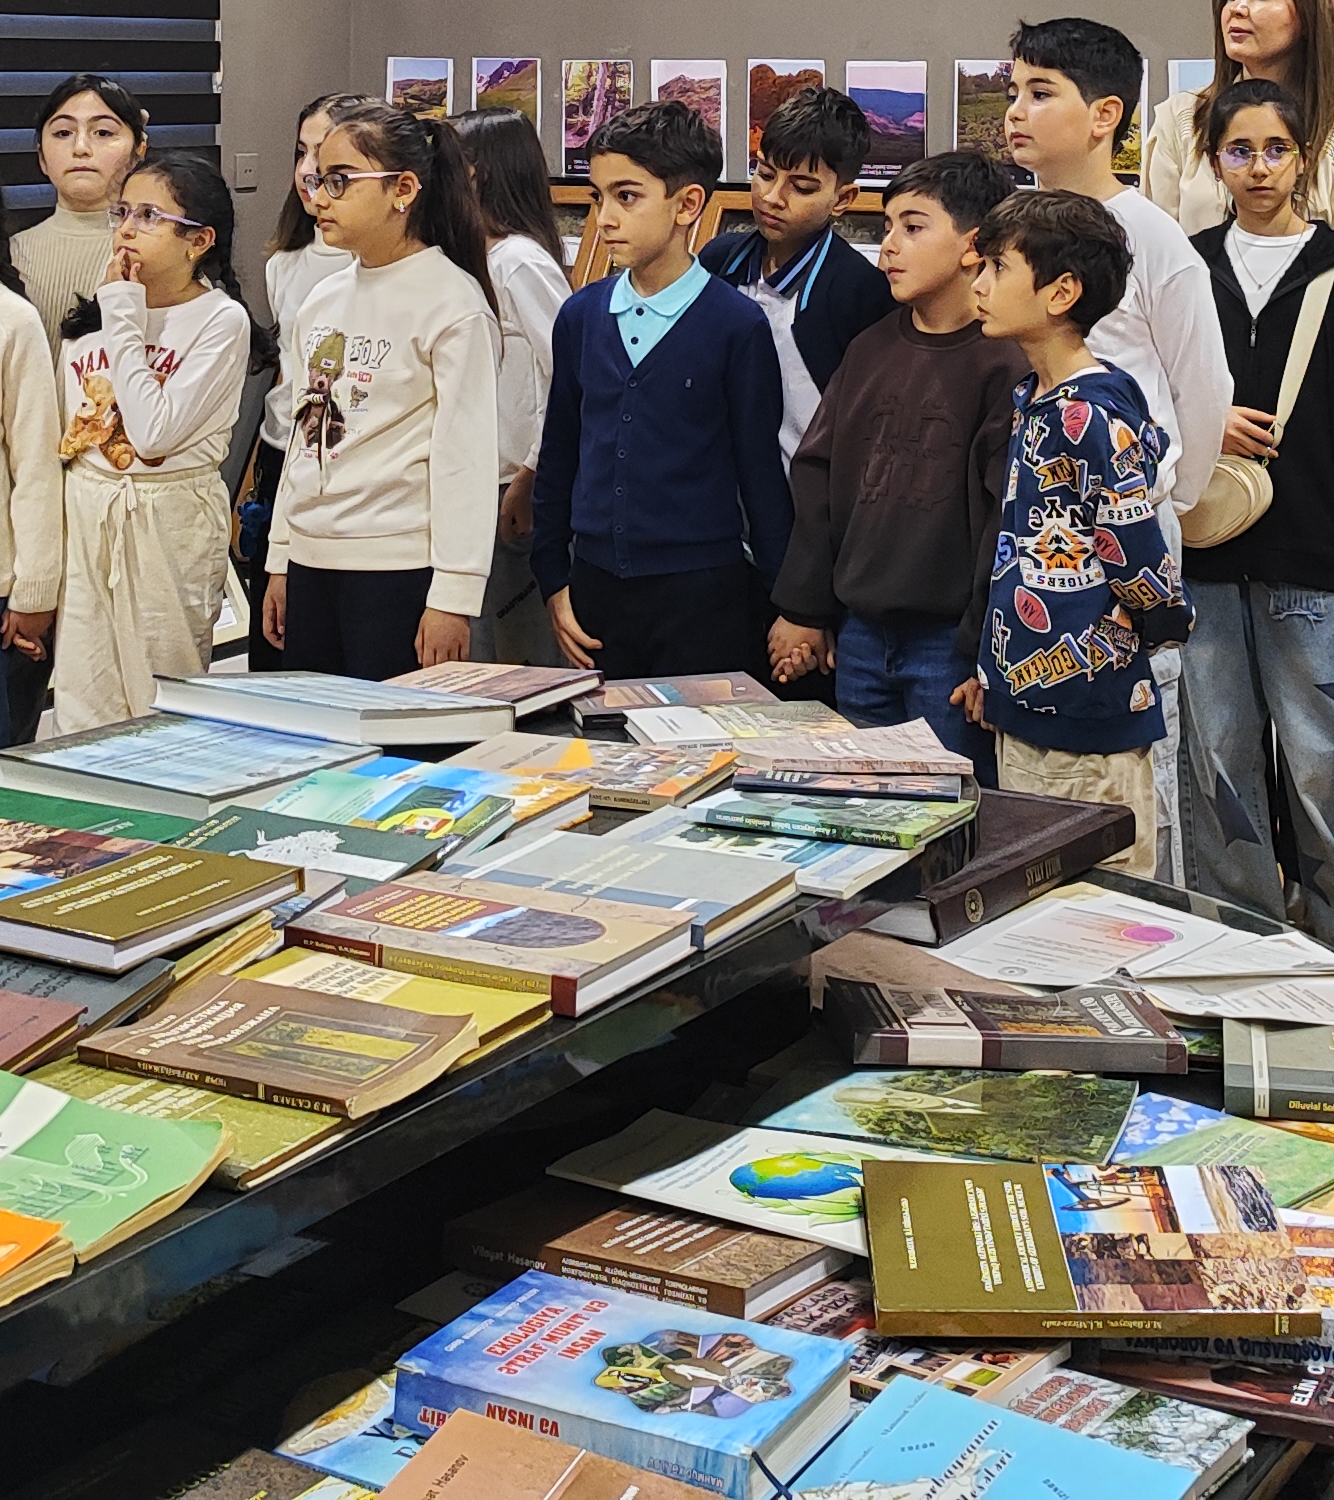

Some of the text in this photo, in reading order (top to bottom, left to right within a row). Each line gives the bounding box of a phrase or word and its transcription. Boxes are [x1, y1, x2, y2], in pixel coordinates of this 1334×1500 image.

[350, 335, 391, 369] TOY
[1107, 502, 1150, 520] IGERS
[1036, 573, 1096, 588] TIGERS
[1288, 1100, 1321, 1112] Diluvial
[496, 1342, 548, 1375] ƏTRAF
[1290, 1378, 1319, 1406] ELİN
[419, 1407, 448, 1429] HİT
[539, 1417, 560, 1437] VƏ
[432, 1453, 469, 1488] Hasanov
